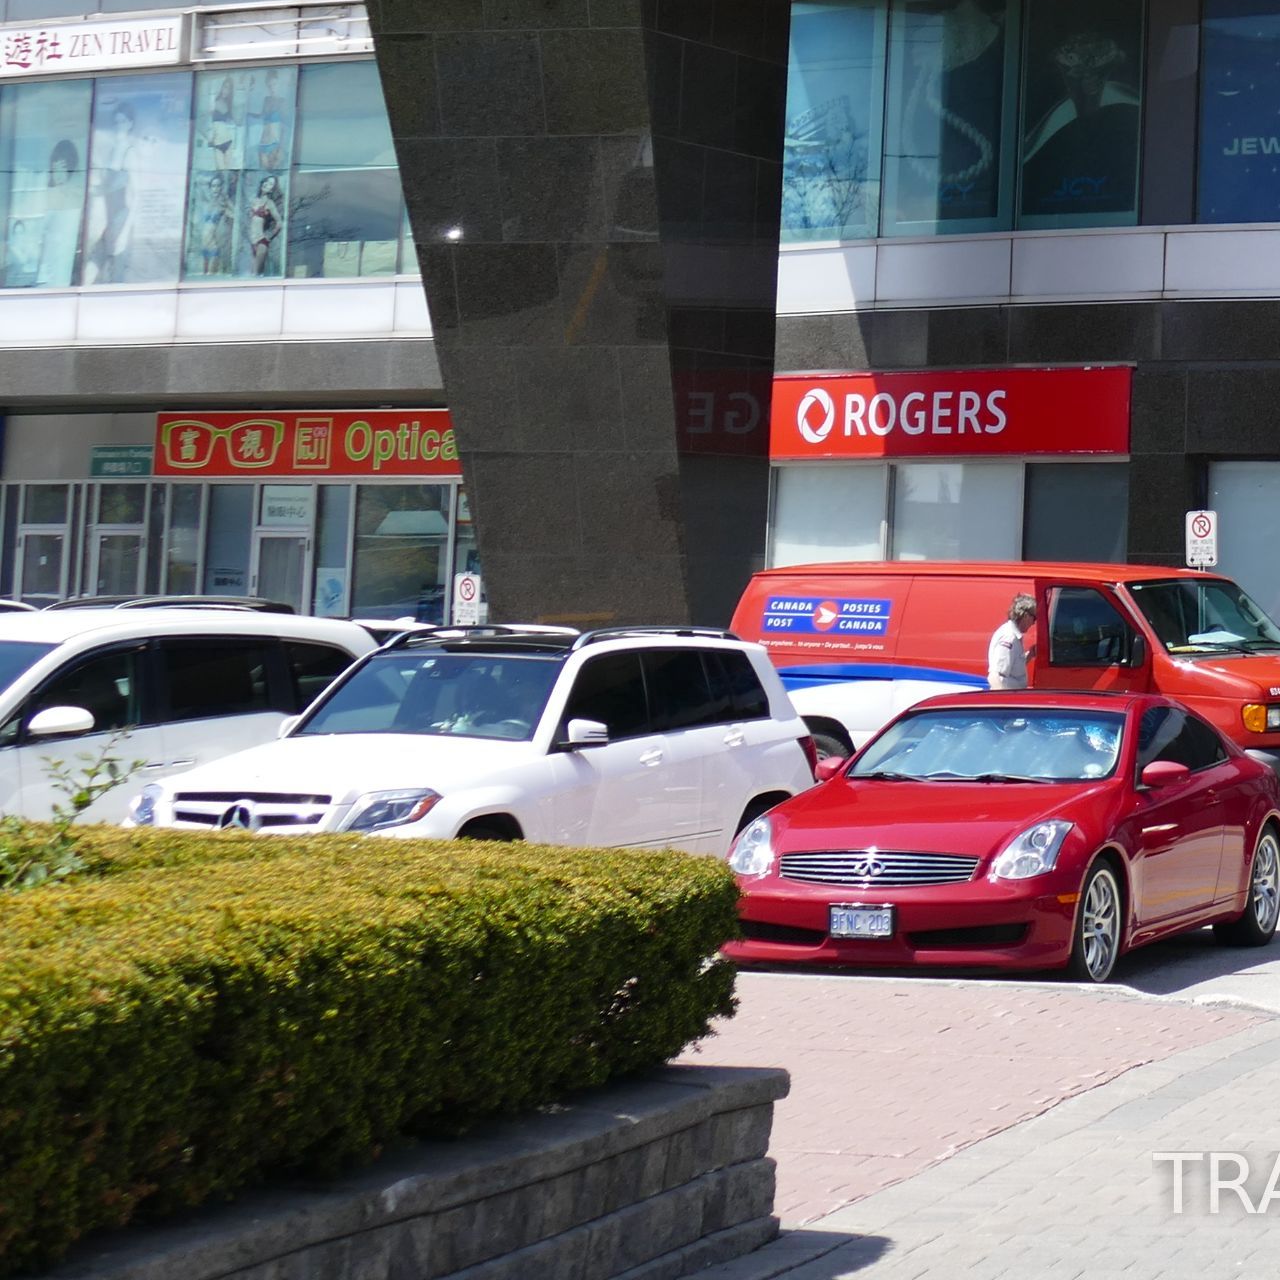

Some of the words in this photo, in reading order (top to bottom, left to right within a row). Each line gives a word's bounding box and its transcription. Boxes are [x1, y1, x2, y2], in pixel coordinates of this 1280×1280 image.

[69, 33, 104, 58] ZEN
[110, 27, 177, 55] TRAVEL
[843, 389, 1007, 437] ROGERS
[770, 601, 813, 611] CANADA
[842, 603, 881, 613] POSTES
[767, 617, 793, 627] POST
[839, 620, 882, 630] CANADA
